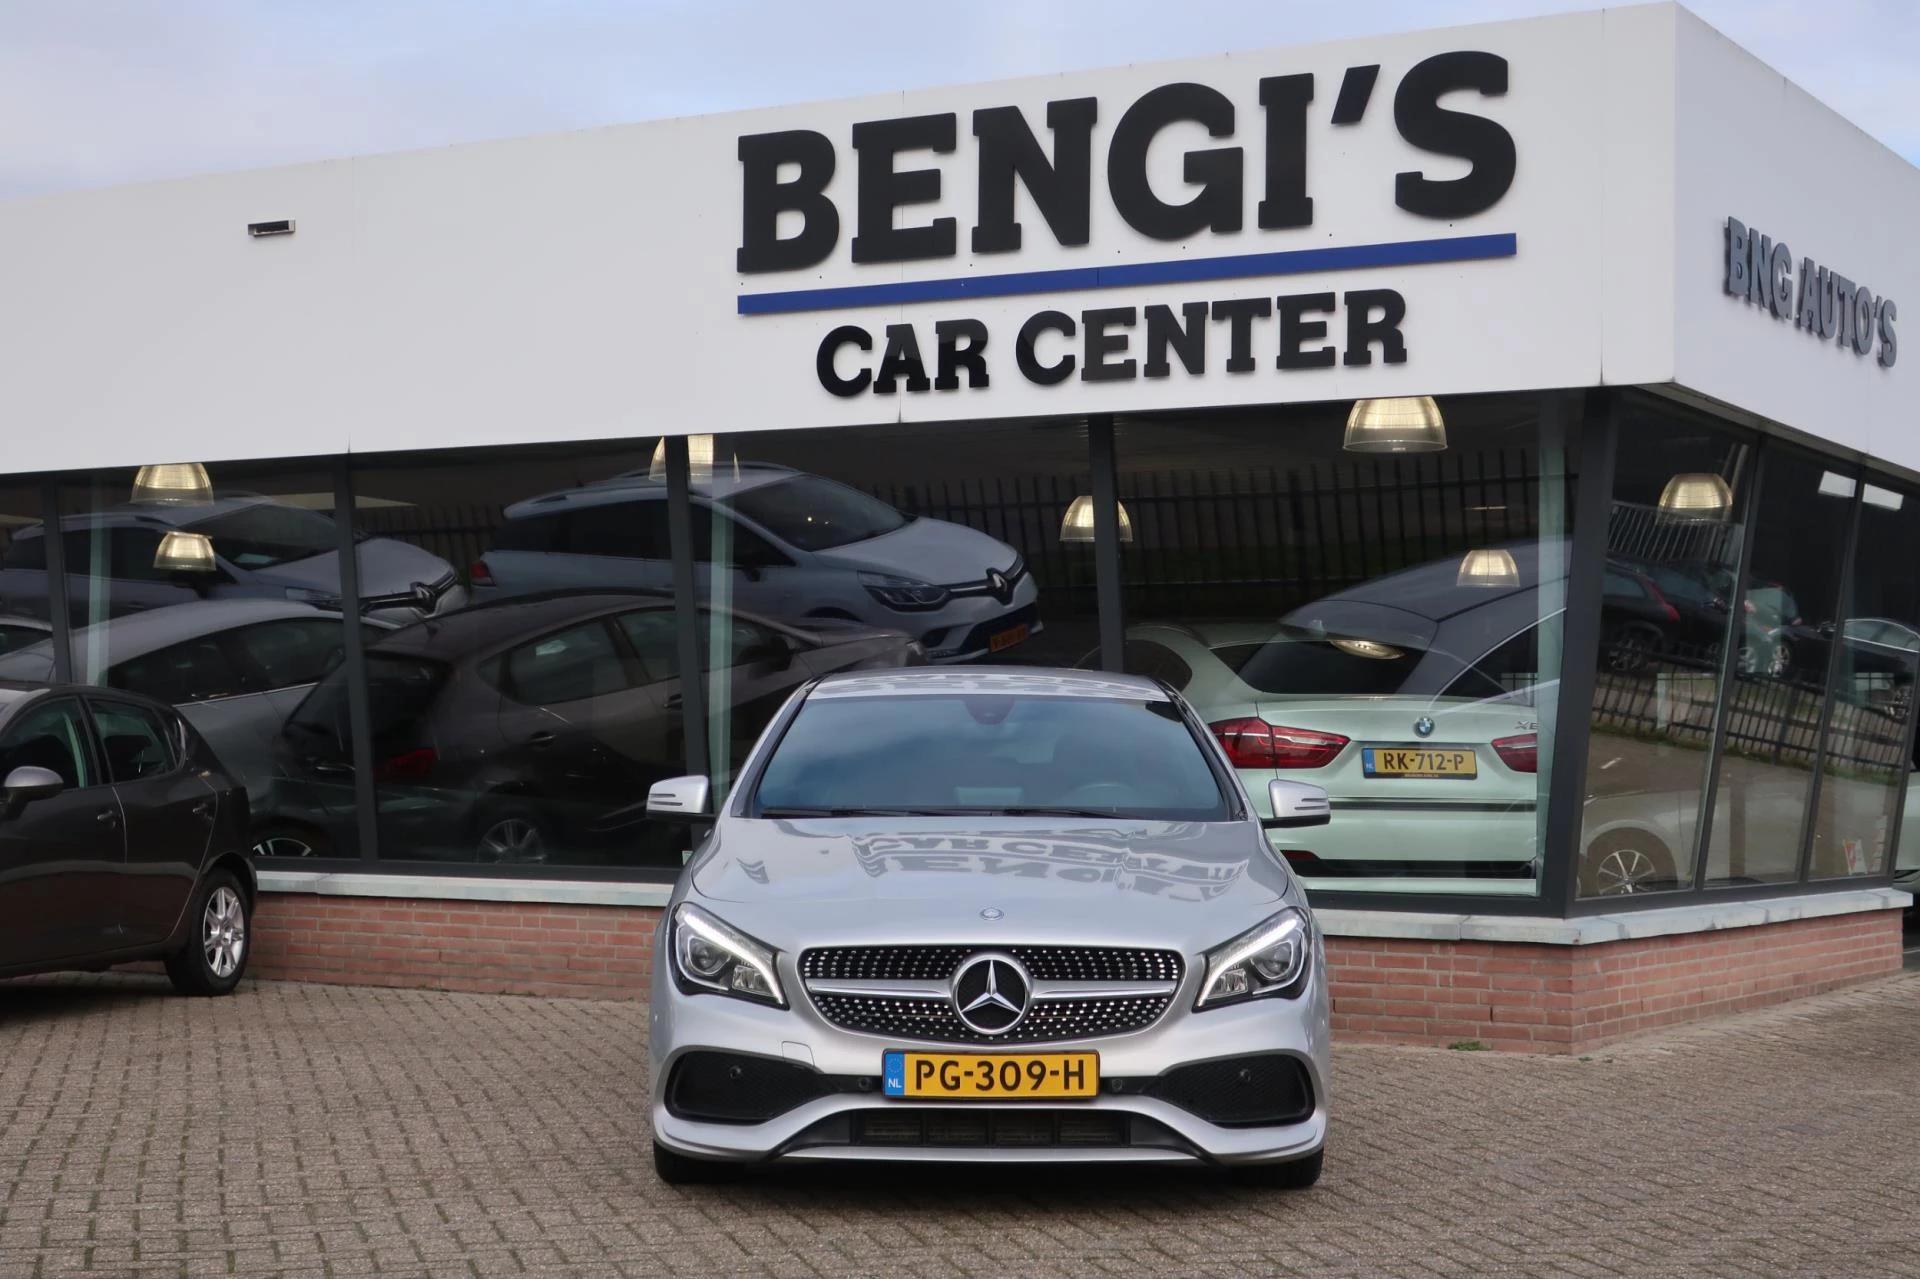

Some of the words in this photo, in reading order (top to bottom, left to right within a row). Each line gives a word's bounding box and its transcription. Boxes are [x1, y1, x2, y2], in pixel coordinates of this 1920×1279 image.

[737, 50, 1517, 273] BENGI'S
[816, 319, 990, 397] CAR
[1016, 289, 1408, 386] CENTER
[1724, 216, 1793, 320] BNG
[1799, 256, 1897, 368] AUTO'S
[1383, 752, 1464, 771] RK-712-P
[887, 1078, 902, 1088] NL
[915, 1059, 1085, 1092] PG-309-H
